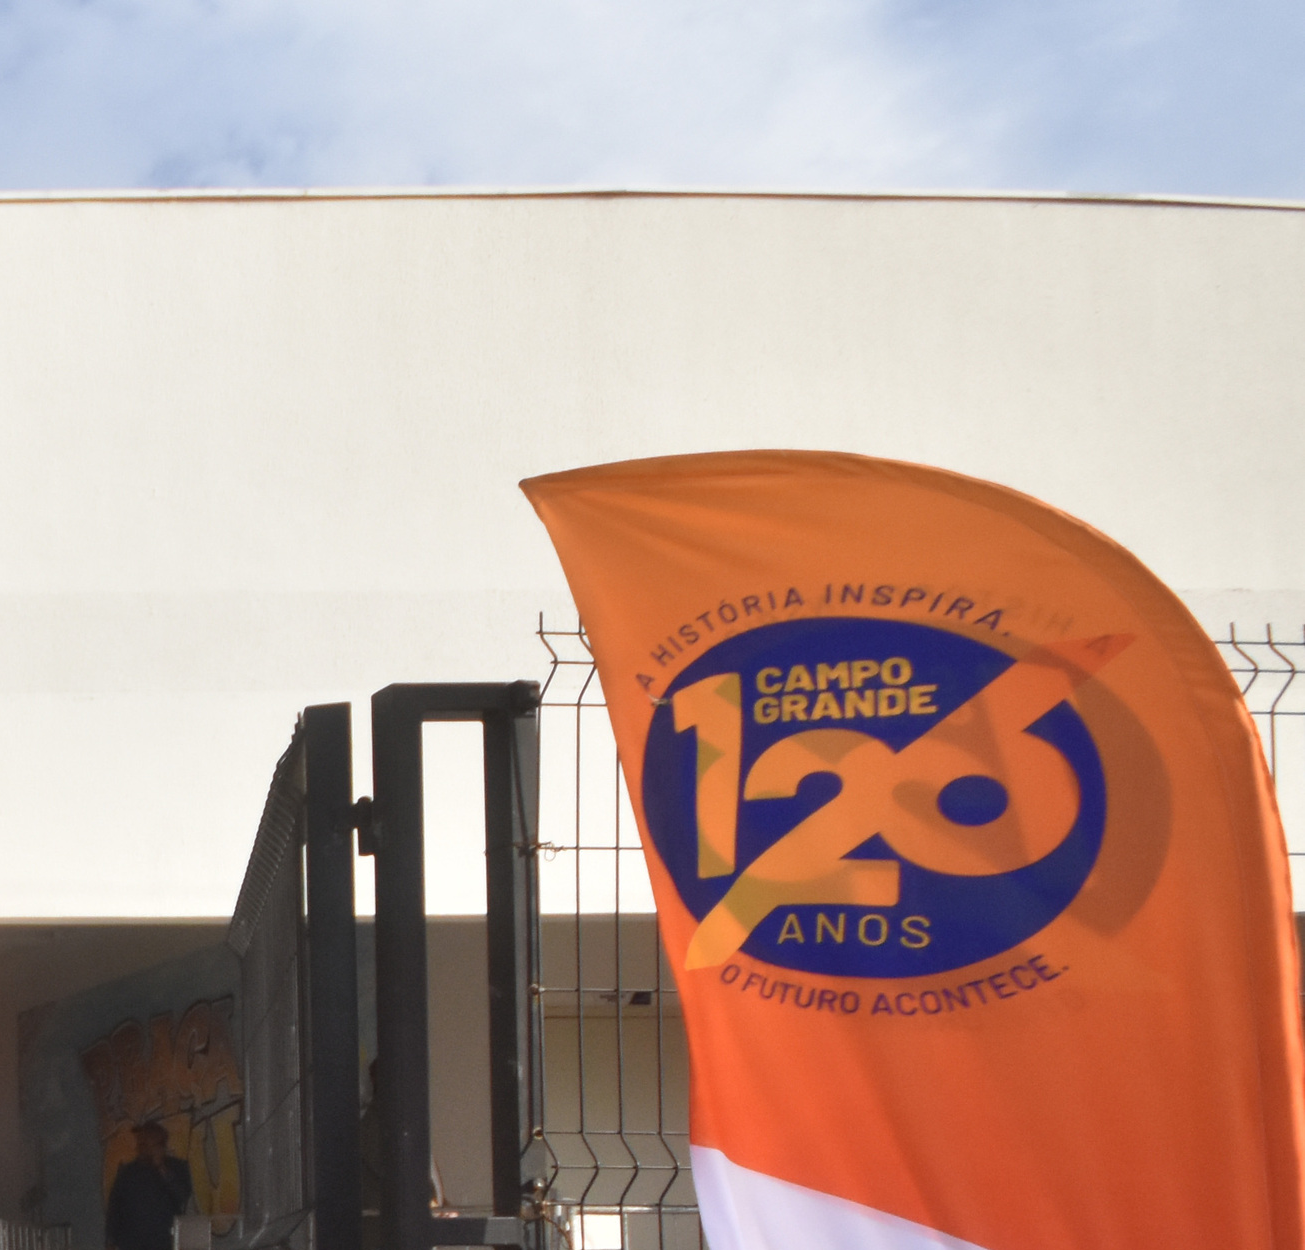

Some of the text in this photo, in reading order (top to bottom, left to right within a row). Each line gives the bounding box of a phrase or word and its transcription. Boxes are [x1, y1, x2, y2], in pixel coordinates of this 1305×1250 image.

[634, 671, 656, 692] A
[649, 587, 805, 667] HISTÓRIA
[755, 657, 912, 695] CAMPO
[753, 684, 939, 725] GRANDE
[671, 633, 1139, 971] 126
[777, 912, 932, 949] ANOS
[720, 964, 742, 985] O
[741, 973, 861, 1015] FUTURO
